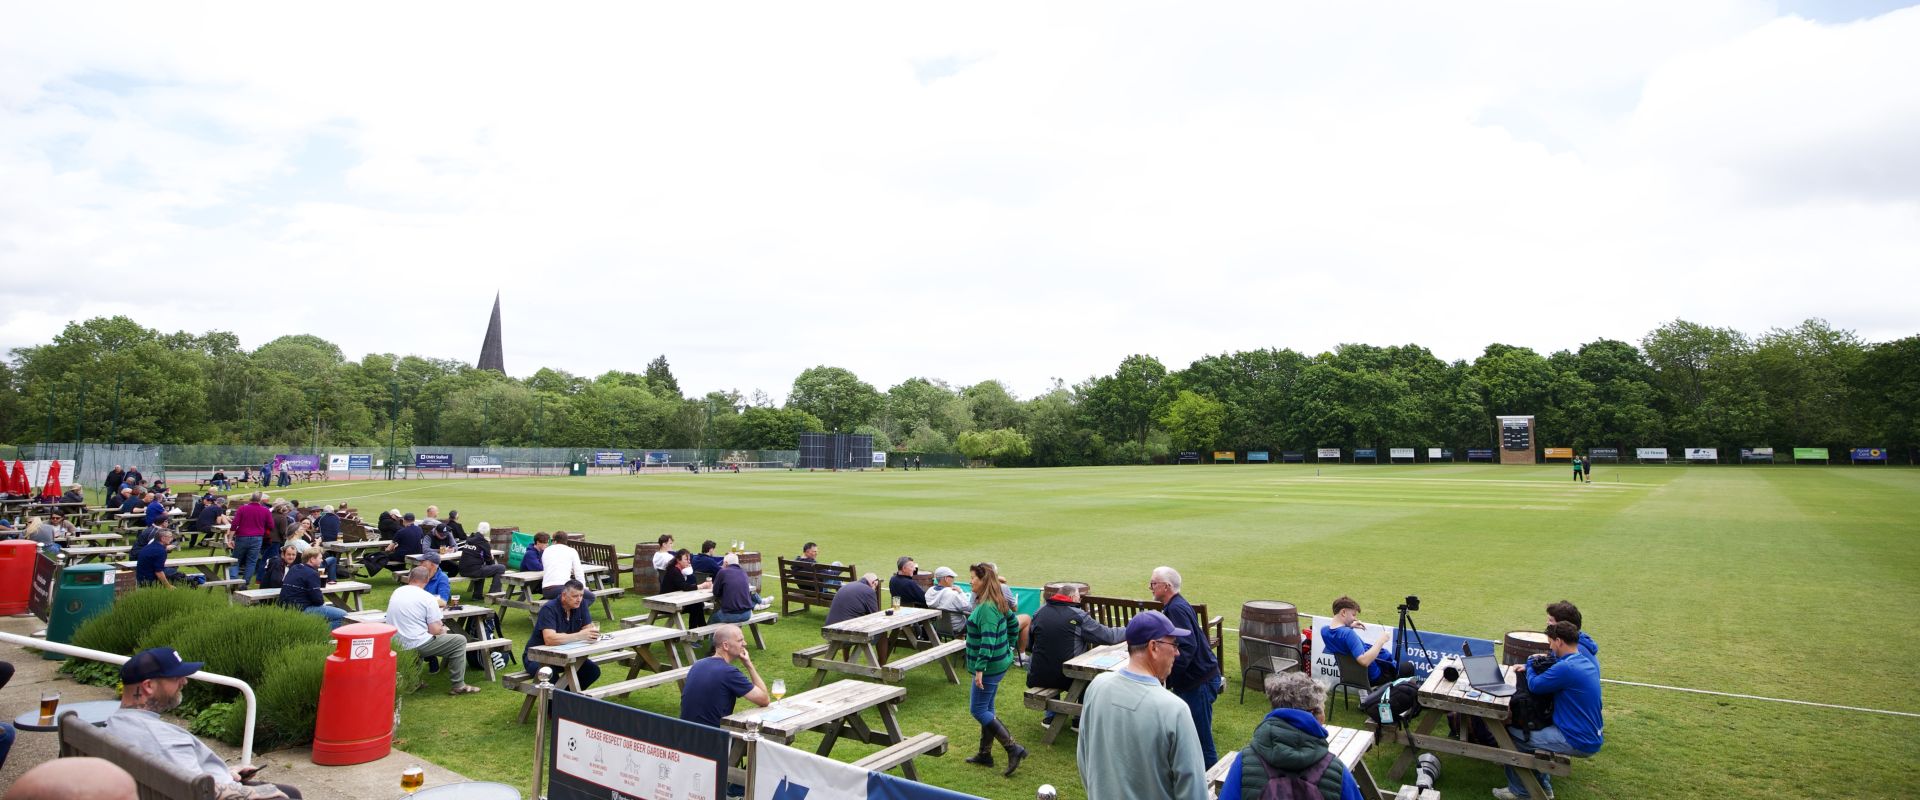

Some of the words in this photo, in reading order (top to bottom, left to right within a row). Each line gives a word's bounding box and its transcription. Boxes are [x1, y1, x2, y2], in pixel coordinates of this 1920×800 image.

[1315, 657, 1338, 667] ALLA
[1320, 666, 1341, 678] BUIL
[585, 728, 604, 742] PLEASE
[602, 734, 622, 748] RESPECT
[622, 739, 633, 750] OUR
[633, 741, 647, 754] BEER
[646, 745, 667, 760] GARDEN
[667, 751, 680, 764] AREA
